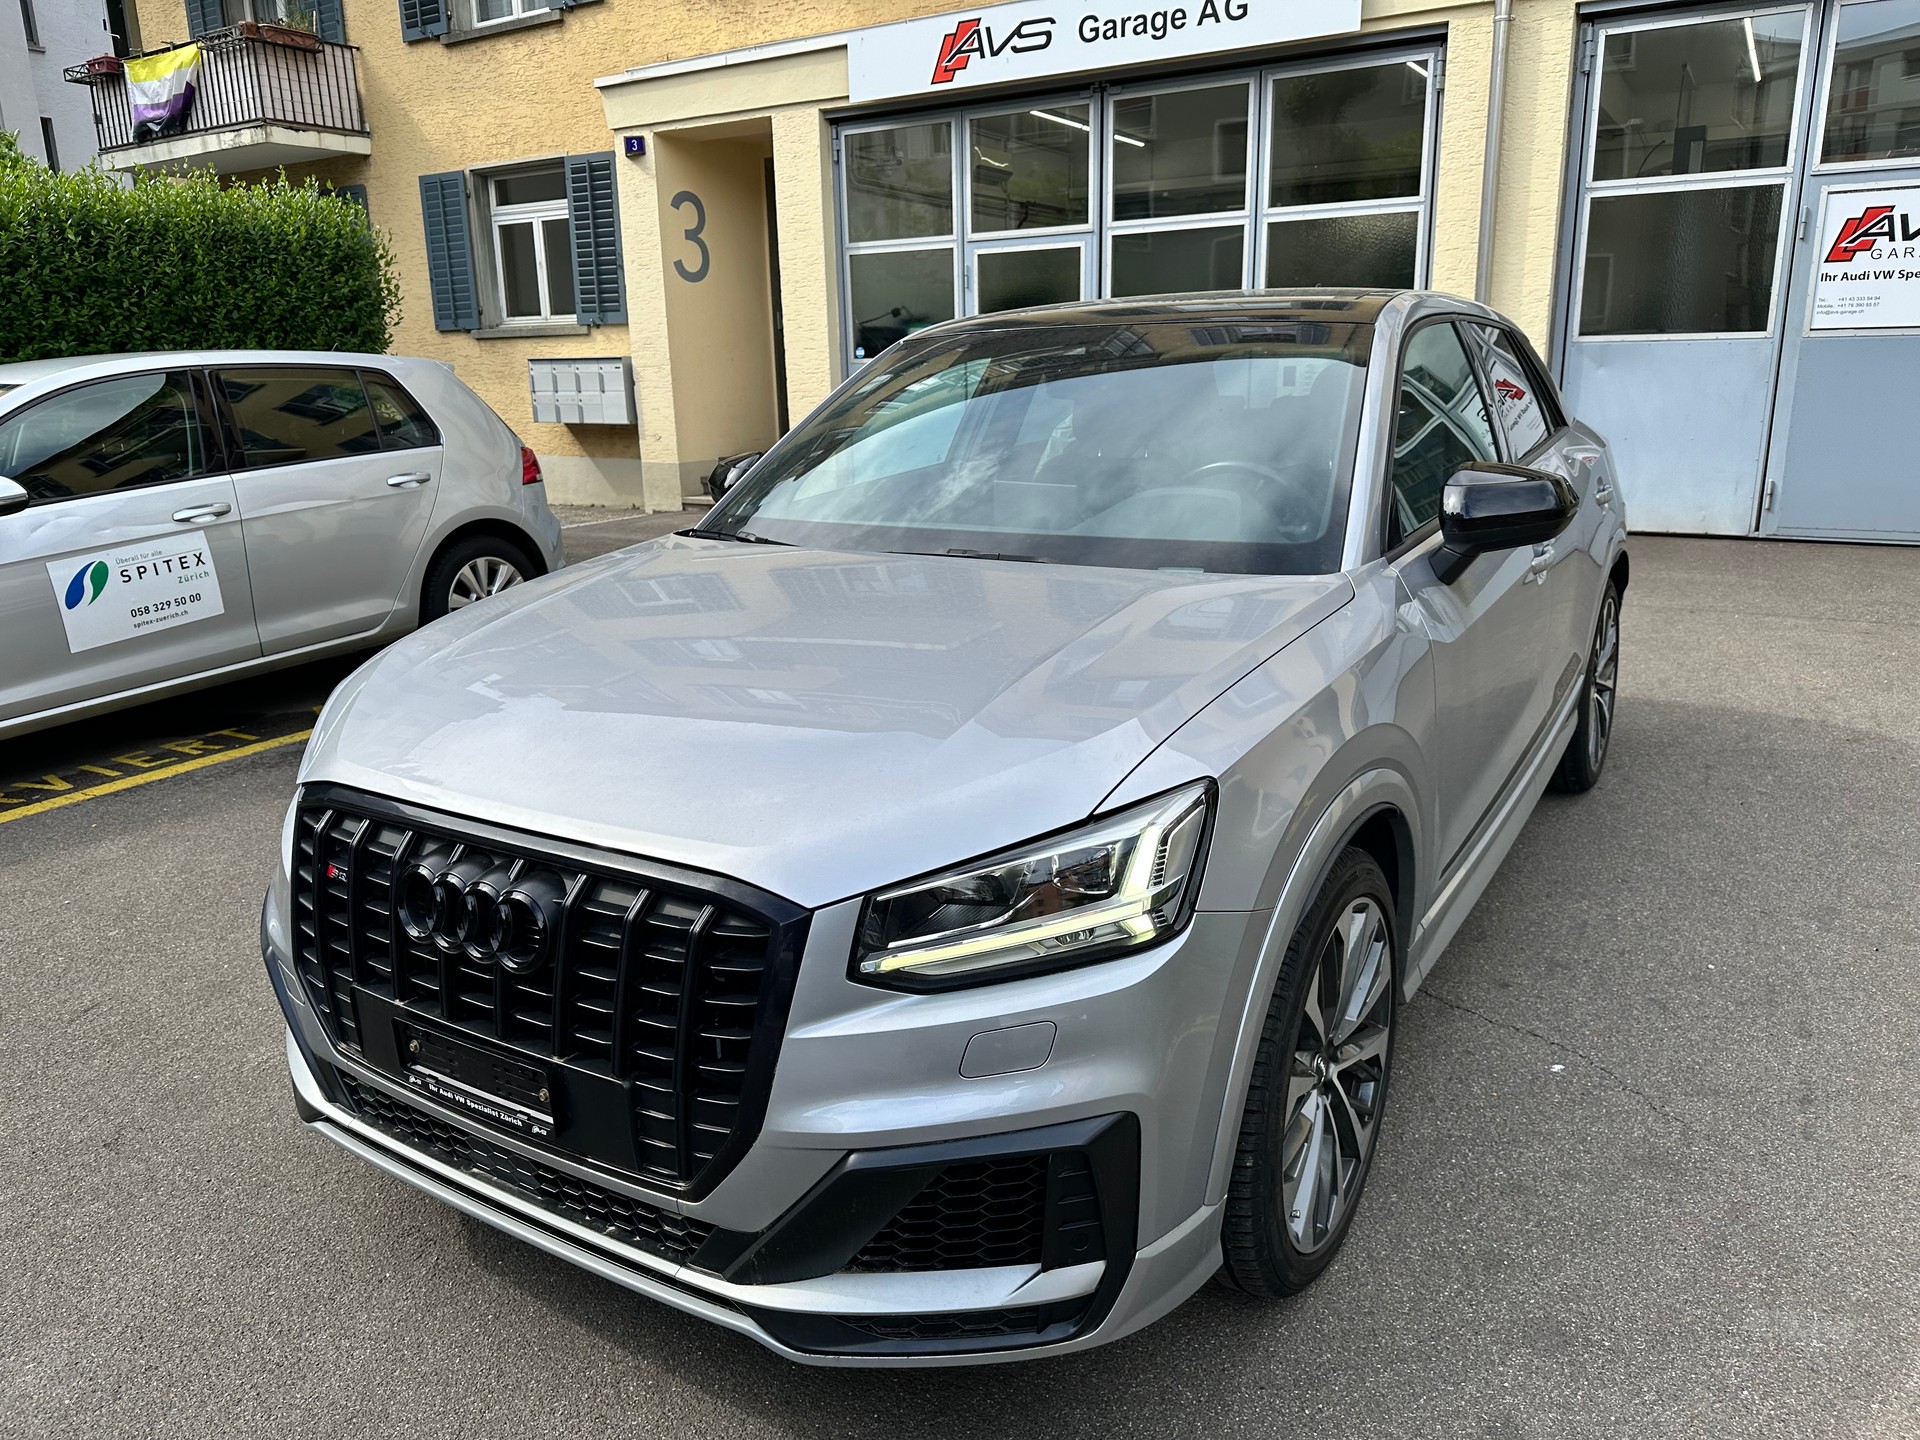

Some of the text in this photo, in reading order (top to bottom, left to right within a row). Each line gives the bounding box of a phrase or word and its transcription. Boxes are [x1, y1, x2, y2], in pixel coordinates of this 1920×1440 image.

[943, 0, 1248, 64] AVS Garage AG
[631, 139, 638, 151] 3
[670, 190, 710, 283] 3
[1820, 272, 1838, 282] Ihr
[1840, 271, 1870, 281] Audi
[1873, 270, 1895, 280] VW
[115, 554, 139, 565] Überall
[140, 551, 150, 560] für
[120, 552, 205, 583] SPITEX
[177, 570, 210, 584] Zürich
[130, 593, 202, 618] 058 329 50 00
[133, 610, 188, 628] spitex-zuerich.ch
[429, 1083, 522, 1127] Ihr Audi VW Spezialist Zürich
